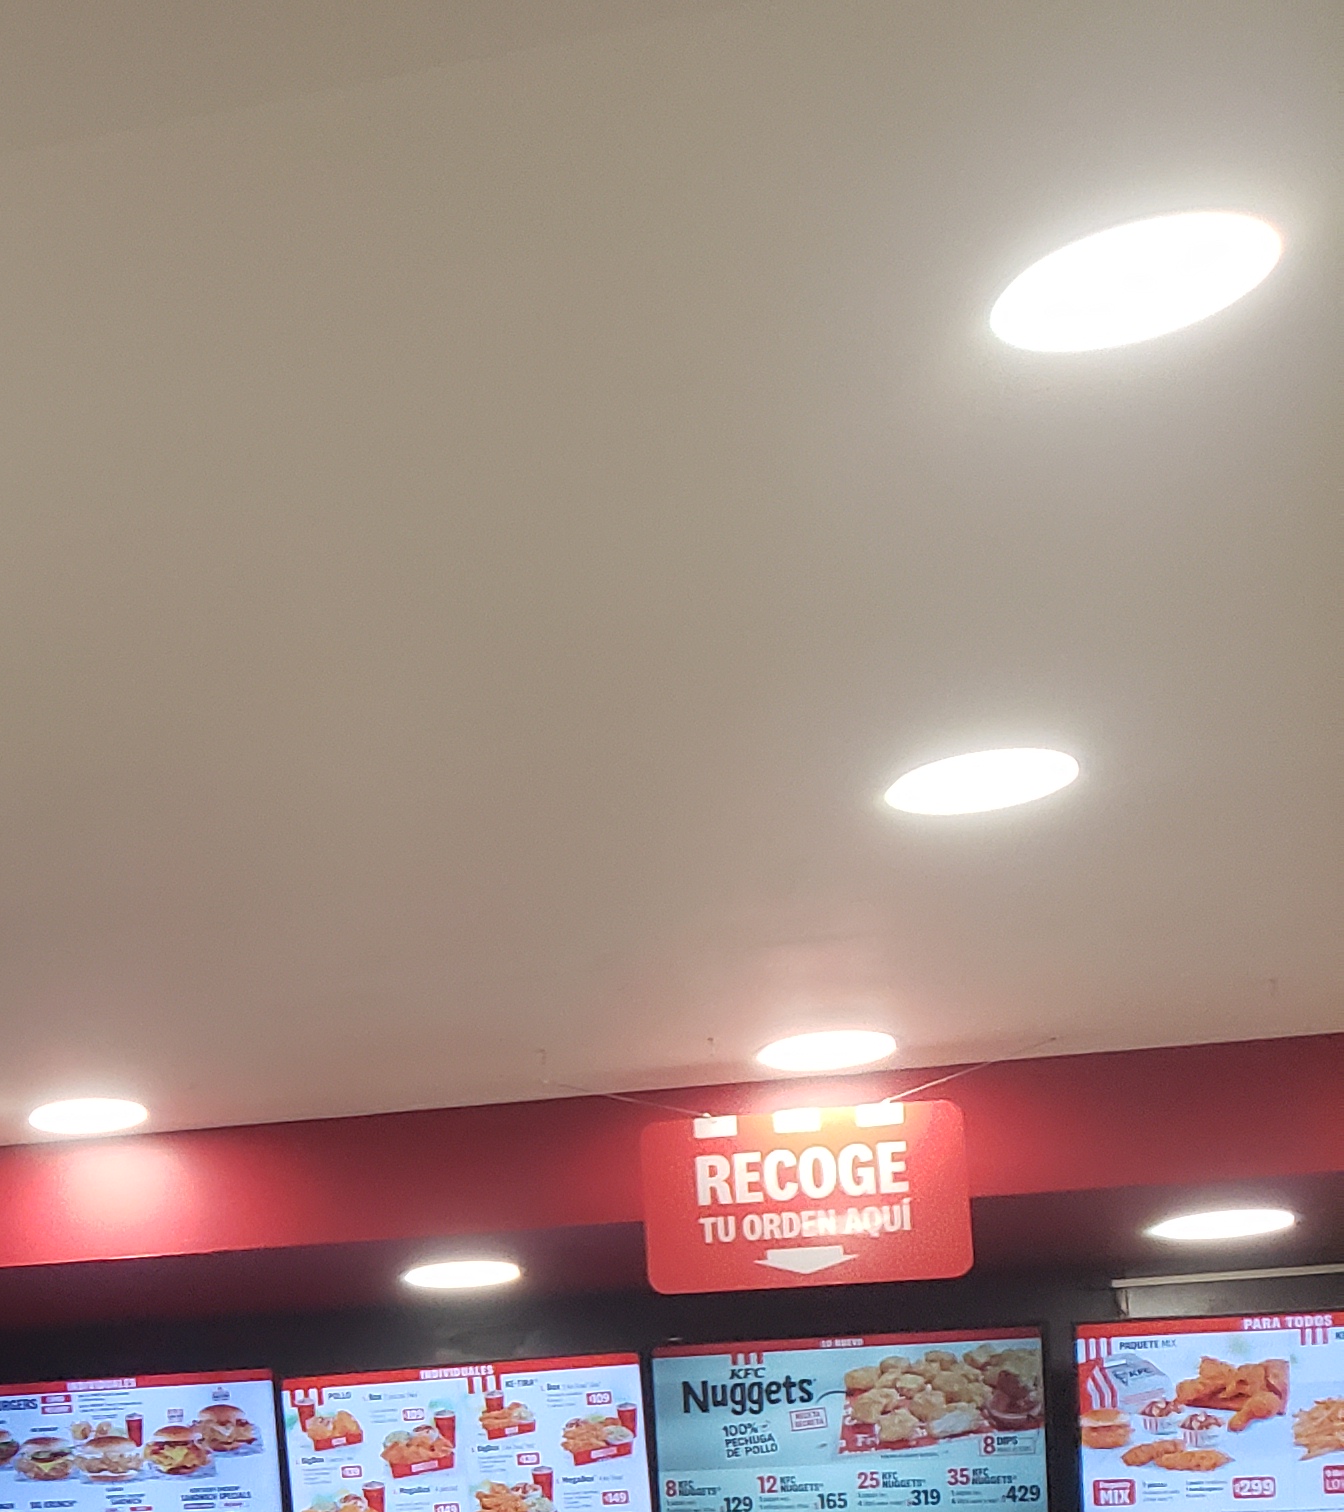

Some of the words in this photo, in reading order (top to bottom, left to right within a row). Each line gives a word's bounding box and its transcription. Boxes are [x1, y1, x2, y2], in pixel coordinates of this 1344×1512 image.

[695, 1140, 910, 1207] RECOGE
[698, 1215, 736, 1244] TU
[742, 1207, 837, 1241] ORDEN
[844, 1197, 912, 1238] AQUÍ
[1243, 1317, 1281, 1330] PARA
[1285, 1314, 1333, 1328] TODOS
[1119, 1340, 1159, 1351] PAQUETE
[419, 1364, 494, 1380] INDIVIDUALES
[729, 1367, 766, 1380] KFC
[682, 1375, 814, 1415] Nuggets
[722, 1422, 758, 1437] 100%
[725, 1433, 776, 1448] PECHUGA
[983, 1436, 995, 1455] 8
[996, 1436, 1019, 1446] DIPS
[726, 1448, 742, 1459] DE
[745, 1442, 779, 1455] POLLO
[757, 1475, 779, 1494] 12
[857, 1471, 880, 1490] 25
[947, 1468, 971, 1486] 35
[665, 1480, 677, 1498] 8
[780, 1482, 824, 1493] NUGGETS
[1099, 1489, 1131, 1505] MIX
